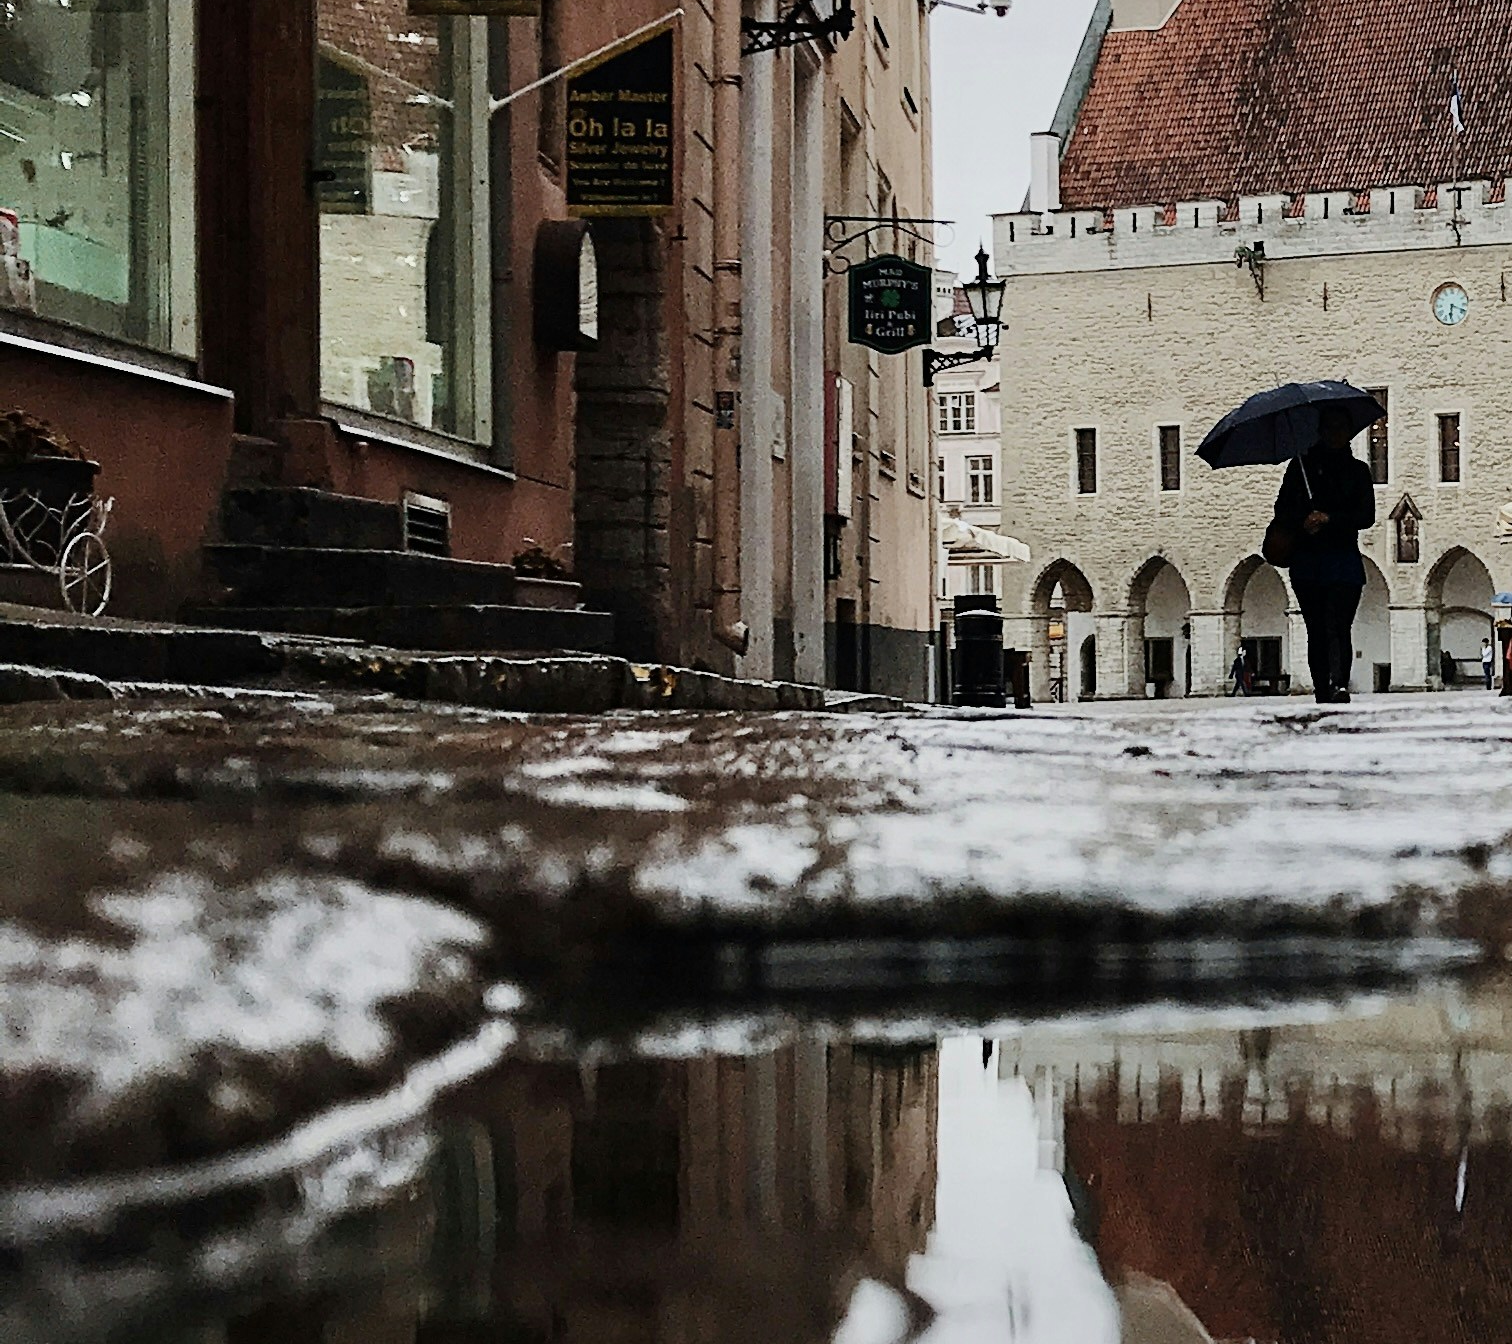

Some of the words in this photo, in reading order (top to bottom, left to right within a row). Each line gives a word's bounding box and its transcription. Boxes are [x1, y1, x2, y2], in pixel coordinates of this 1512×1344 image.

[569, 117, 604, 138] Oh
[613, 116, 637, 138] la
[645, 117, 669, 138] la
[875, 326, 905, 337] Grill
